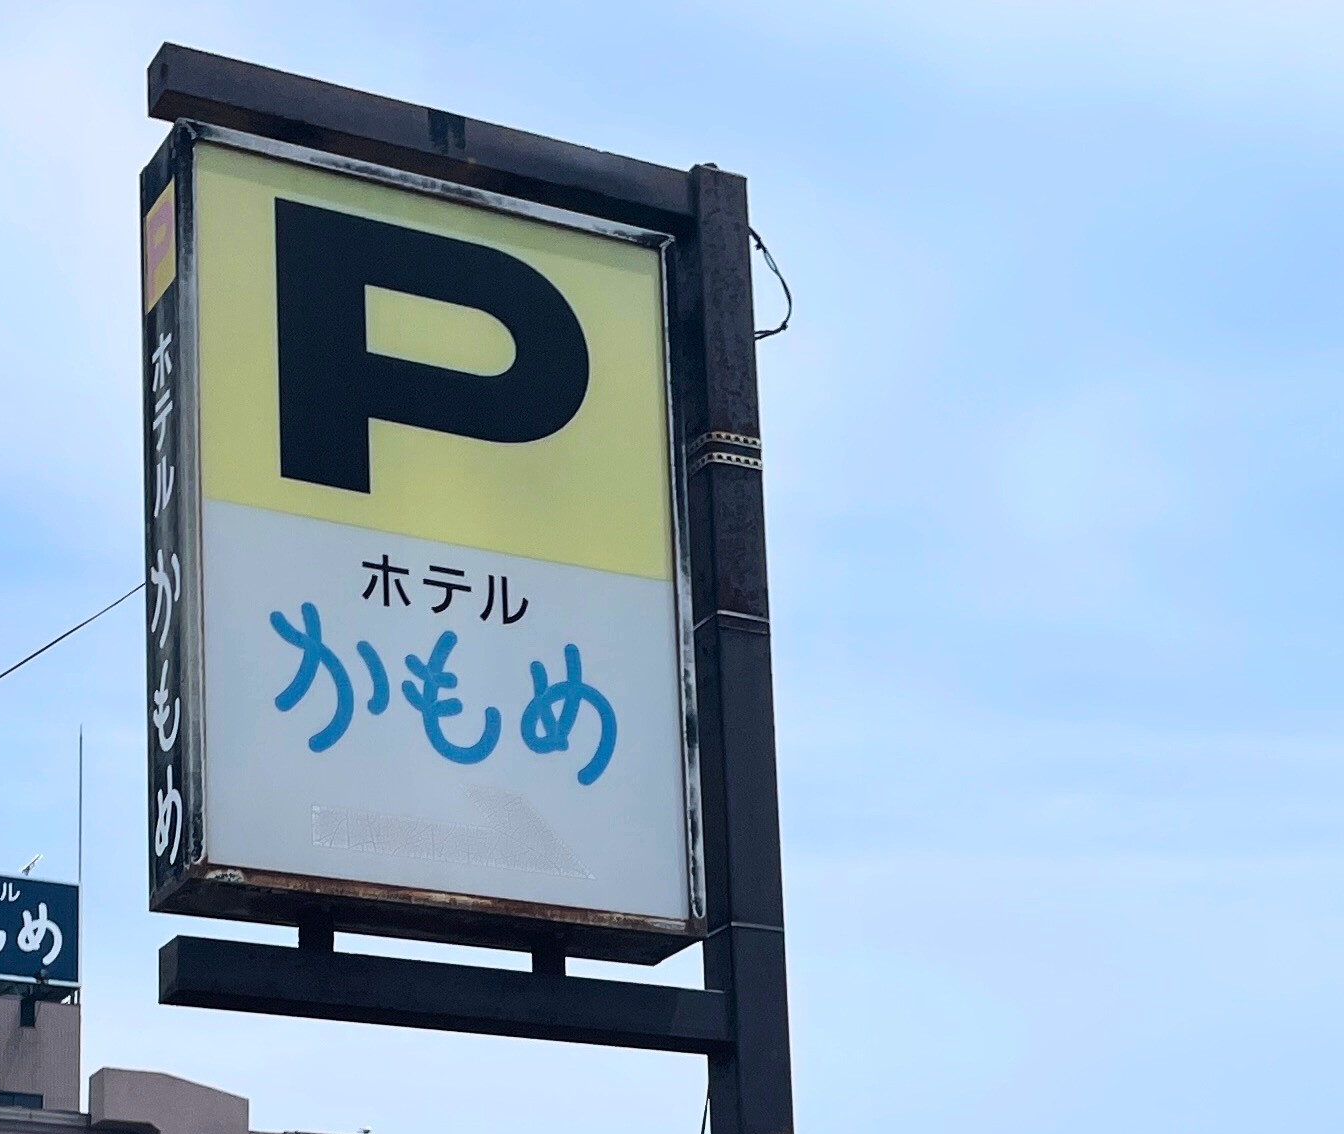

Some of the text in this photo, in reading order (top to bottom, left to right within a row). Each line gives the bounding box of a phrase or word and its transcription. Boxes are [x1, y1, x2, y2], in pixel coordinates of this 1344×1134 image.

[274, 196, 590, 494] P
[361, 554, 529, 625] ホテル
[270, 600, 617, 785] かもめ
